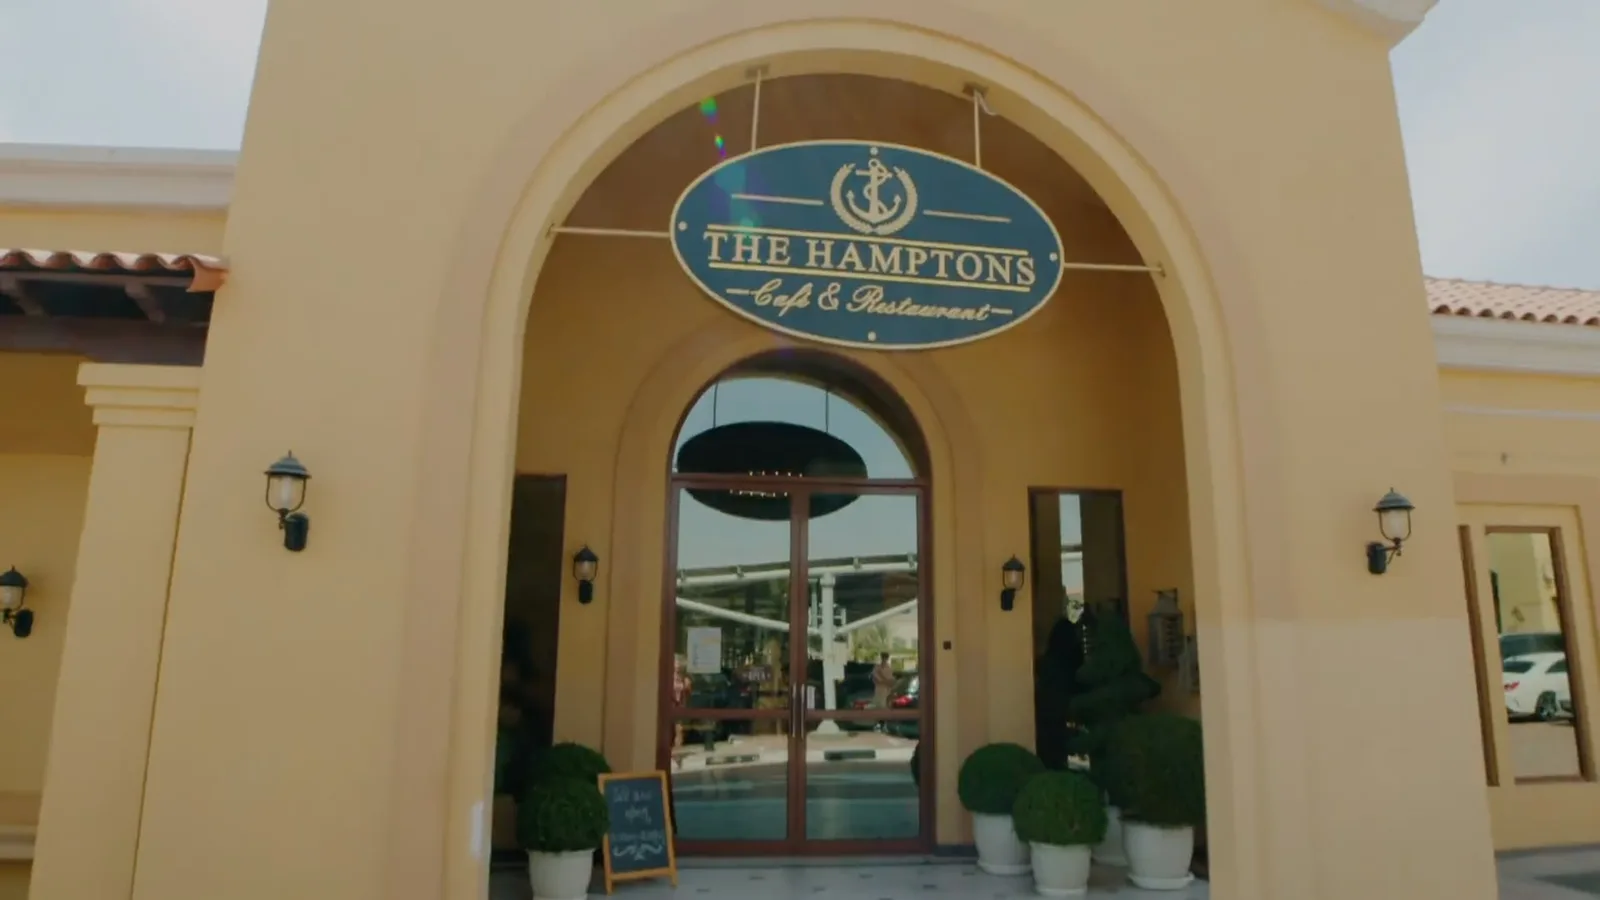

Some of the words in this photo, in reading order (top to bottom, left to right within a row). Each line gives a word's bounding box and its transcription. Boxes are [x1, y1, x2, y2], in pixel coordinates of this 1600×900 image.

[703, 231, 791, 266] THE
[806, 239, 1036, 286] HAMPTONS
[750, 278, 813, 317] Café
[818, 282, 840, 311] &
[846, 284, 991, 321] Restaurant
